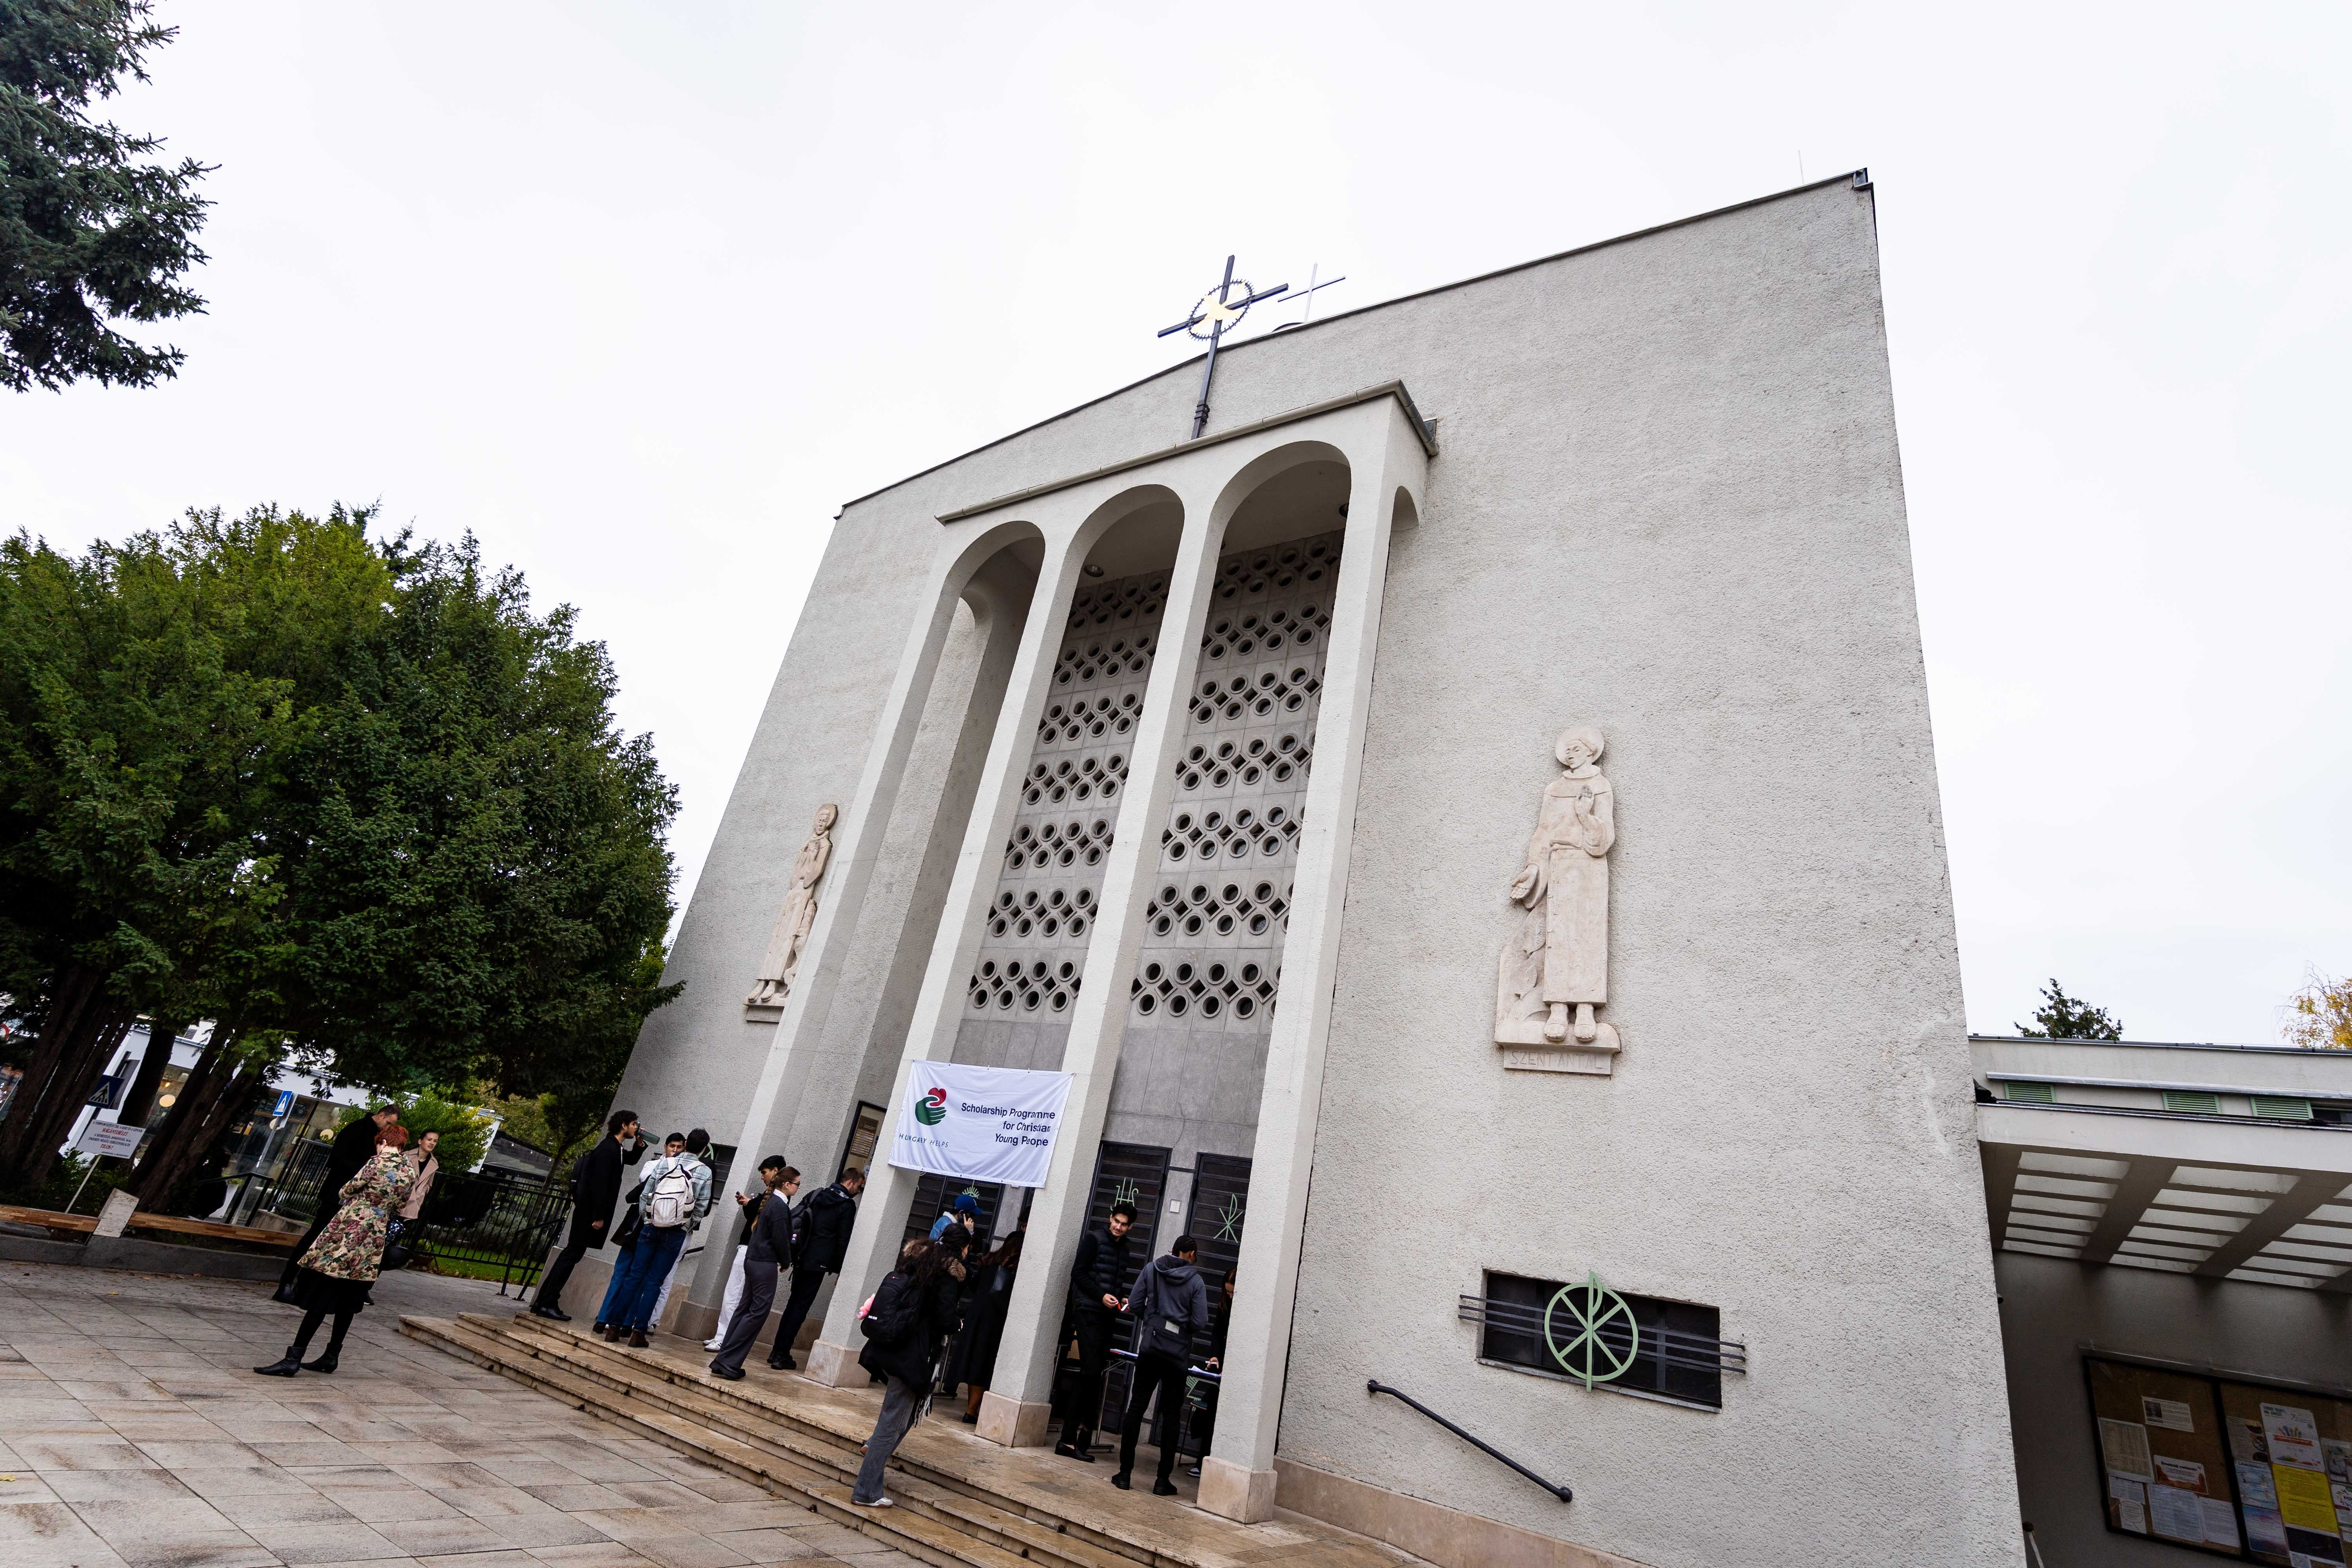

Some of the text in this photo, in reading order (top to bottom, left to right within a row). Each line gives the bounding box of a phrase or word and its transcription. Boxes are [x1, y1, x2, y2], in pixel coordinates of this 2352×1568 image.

[1511, 1051, 1608, 1070] SZENT ANTAL
[961, 1103, 1055, 1120] Scholarship Programme
[1003, 1121, 1051, 1132] for Christian
[899, 1133, 949, 1148] HUNGARY HELPS
[995, 1133, 1049, 1147] Young People
